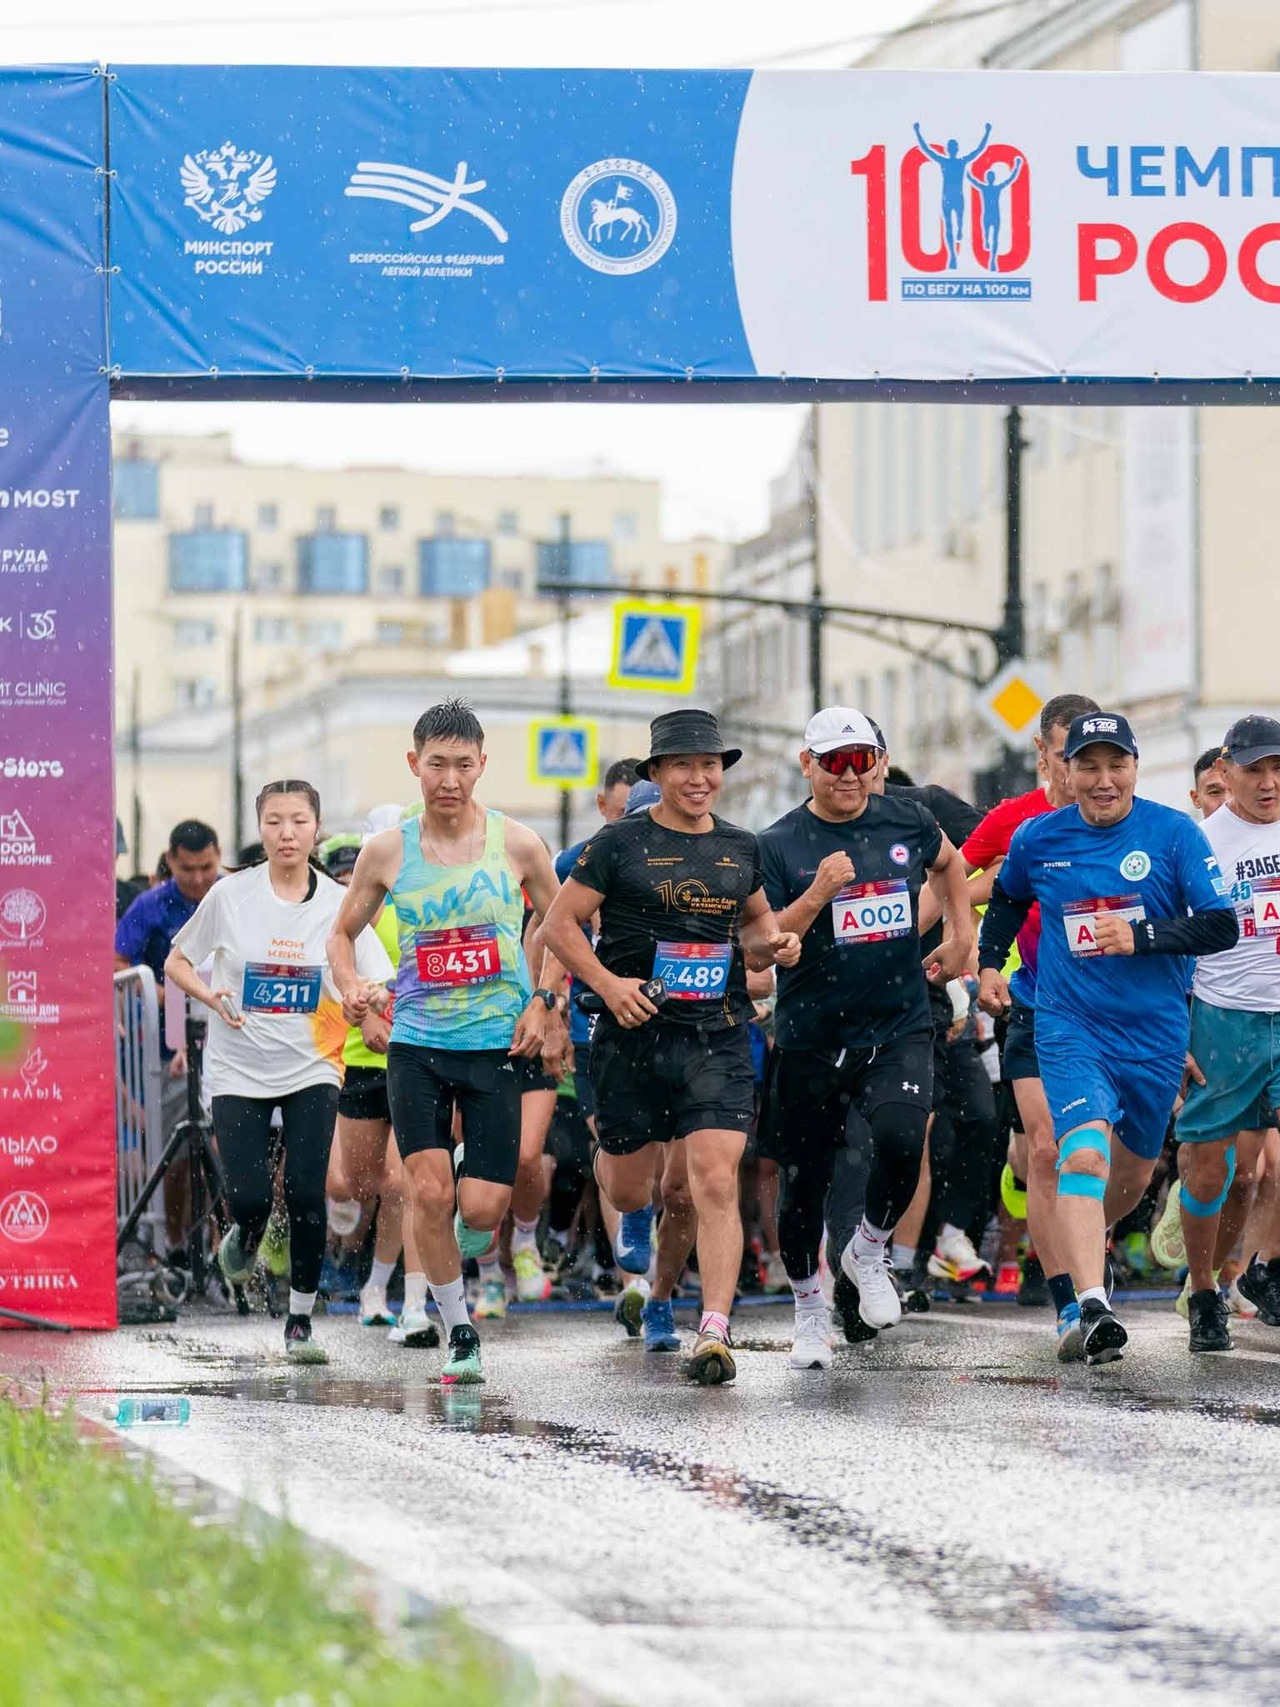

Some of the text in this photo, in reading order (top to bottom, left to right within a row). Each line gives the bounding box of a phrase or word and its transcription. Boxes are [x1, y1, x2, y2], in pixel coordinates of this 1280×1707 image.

[184, 241, 274, 256] МИНСПОРТ
[349, 253, 505, 265] ВСЕРОССИЙСКАЯ ФЕДЕРАЦИЯ
[195, 260, 263, 275] РОССИИ
[381, 266, 473, 277] ЛЕГКОЙ АТЛЕТИКИ
[904, 284, 925, 295] ПО
[928, 284, 960, 295] БЕГУ
[963, 284, 983, 295] НА
[984, 284, 1008, 295] 100
[14, 489, 80, 508] MOST
[15, 682, 66, 696] CLINIC
[841, 903, 906, 931] A002
[271, 938, 304, 949] МОЙ
[267, 950, 307, 960] КЕЙС
[427, 948, 492, 977] 8431
[660, 965, 724, 987] 4489
[253, 982, 310, 1004] 4211
